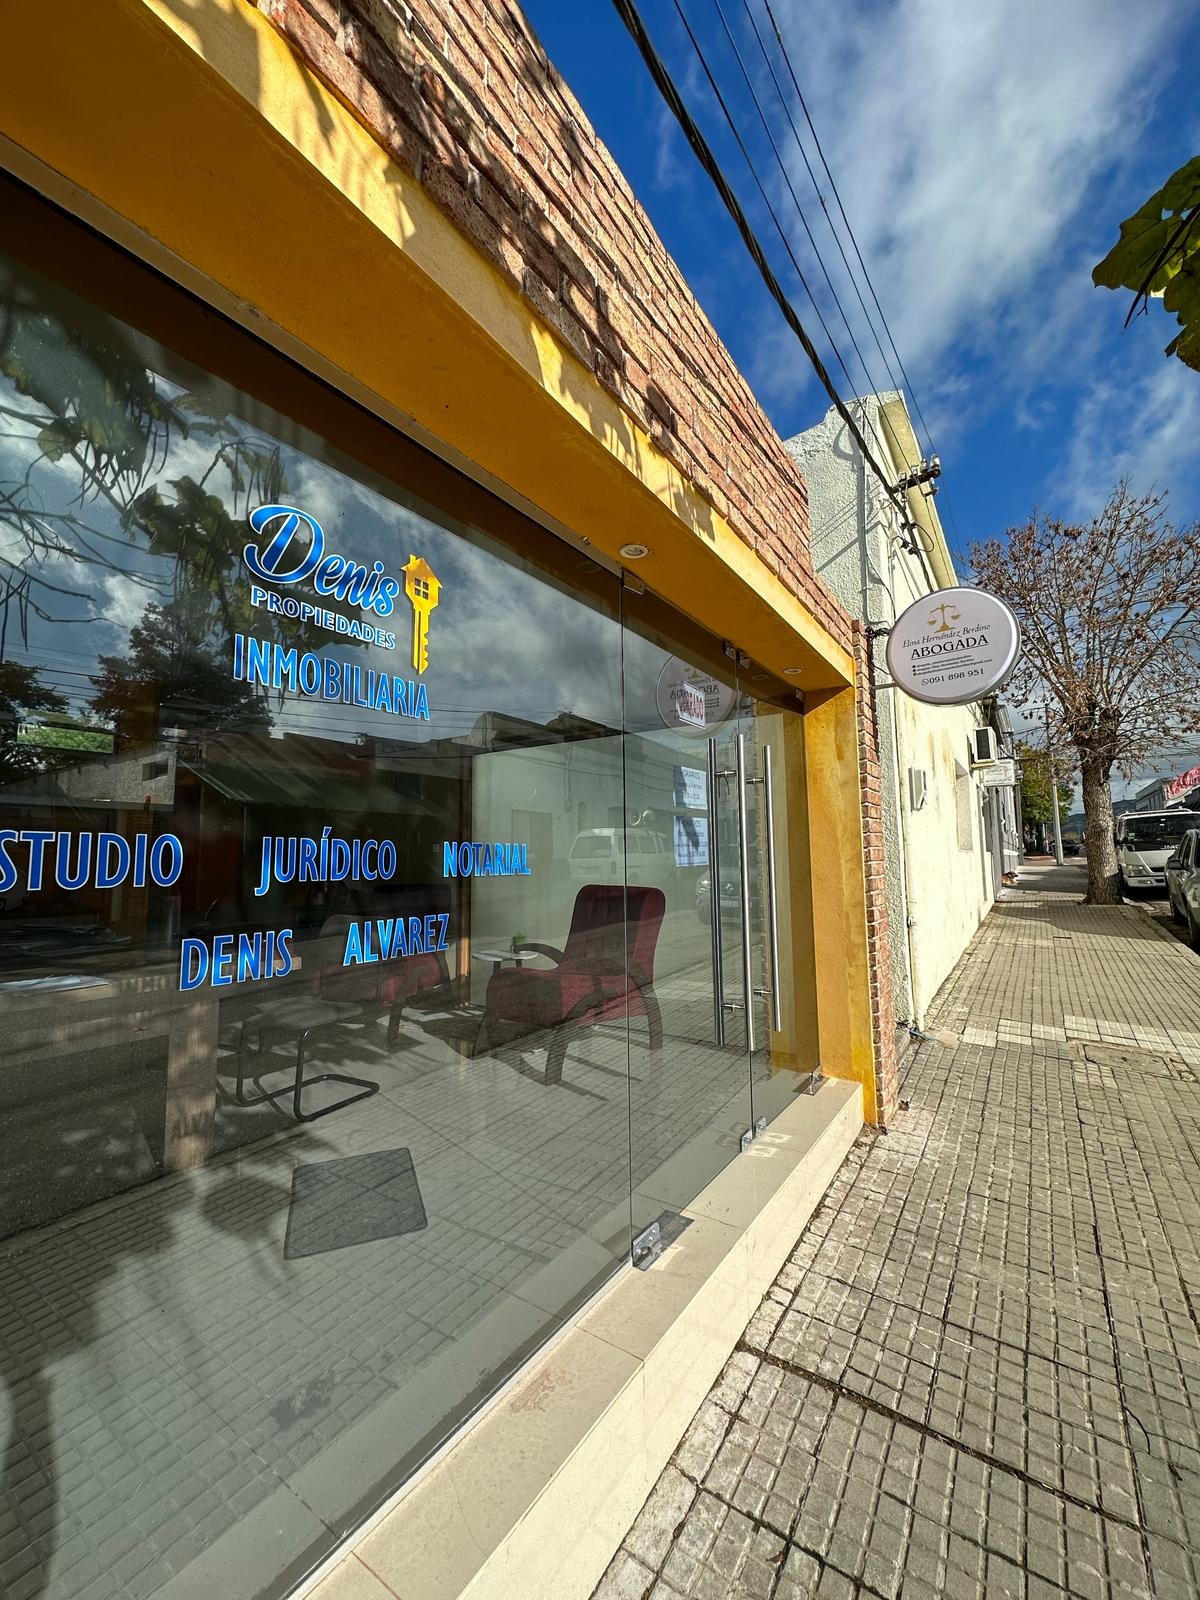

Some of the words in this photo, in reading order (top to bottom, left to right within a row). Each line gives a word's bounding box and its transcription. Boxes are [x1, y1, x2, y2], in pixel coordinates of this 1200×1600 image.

[244, 504, 399, 617] Denis
[251, 585, 396, 650] PROPIEDADES
[911, 635, 989, 659] ABOGADA
[233, 634, 430, 720] INMOBILIARIA
[929, 675, 945, 684] 091
[948, 671, 965, 681] 898
[968, 668, 984, 677] 951
[254, 827, 397, 897] JURÍDICO
[443, 840, 532, 878] NOTARIAL
[178, 929, 293, 992] DENIS
[343, 913, 450, 967] ALVAREZ
